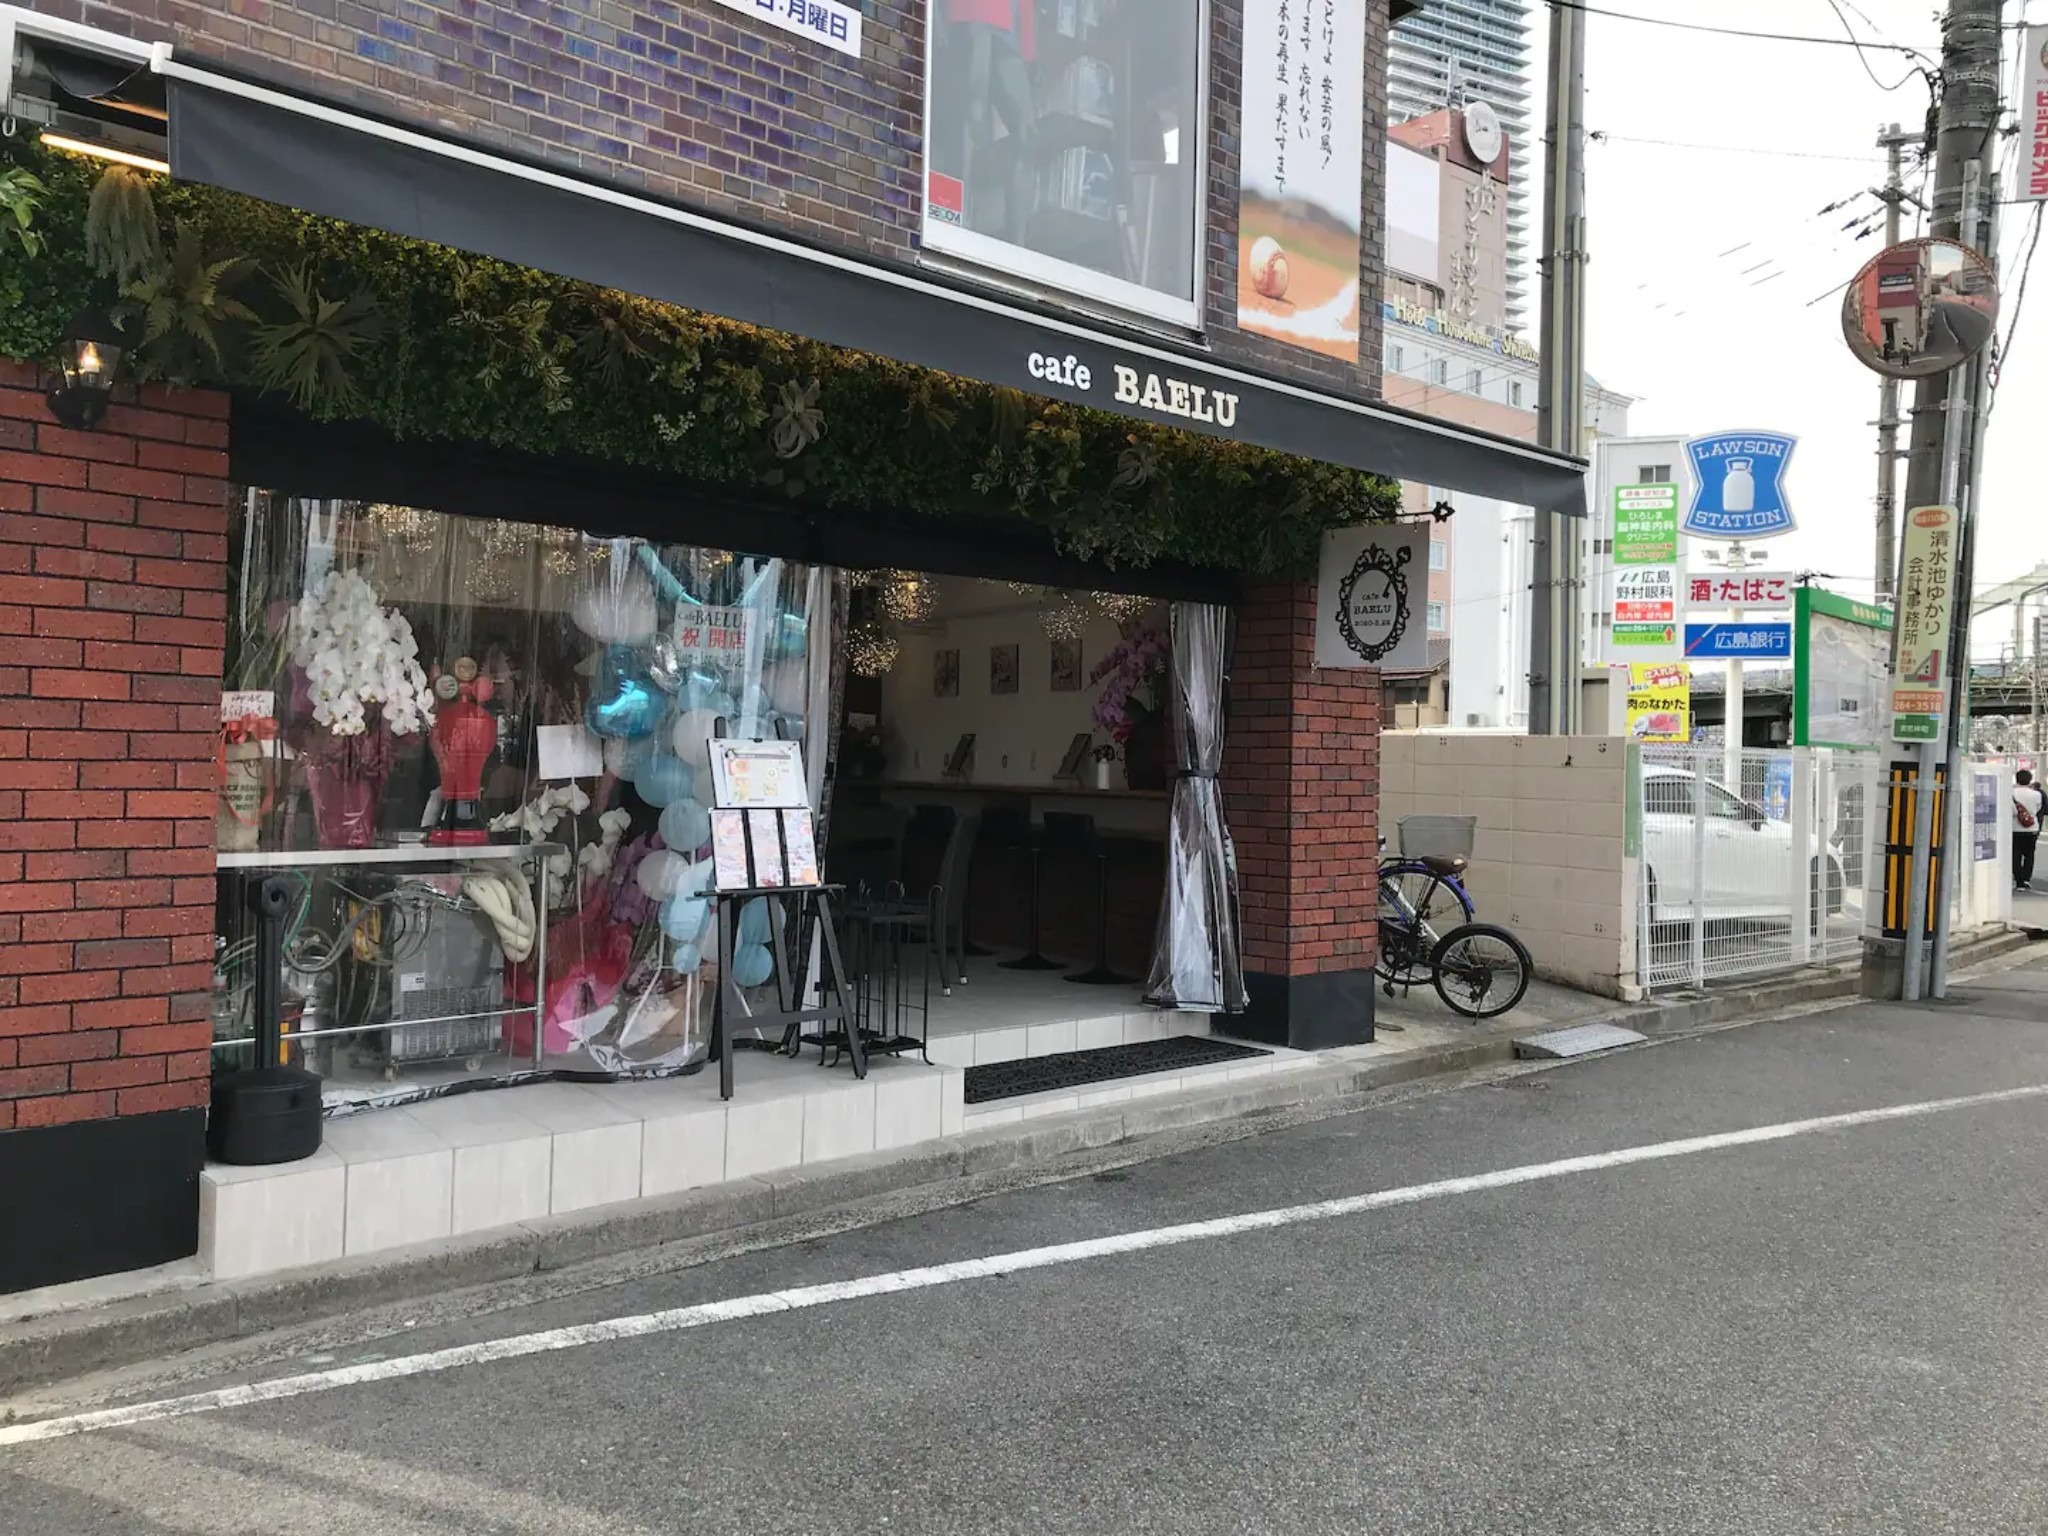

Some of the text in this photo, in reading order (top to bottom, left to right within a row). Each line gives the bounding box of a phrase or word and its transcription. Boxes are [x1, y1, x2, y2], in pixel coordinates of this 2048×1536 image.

[1028, 352, 1240, 428] cafe BAELU
[1696, 440, 1785, 460] LAWSON
[1694, 508, 1782, 528] STATION
[1626, 532, 1665, 541] クリニック
[1641, 570, 1671, 583] 広島
[1925, 530, 1951, 637] 清水池ゆかり
[1616, 585, 1673, 599] 野村眼科
[1690, 578, 1786, 602] 酒・たばこ
[1354, 605, 1392, 615] BAELU
[1903, 556, 1925, 646] 会計事務所
[695, 608, 743, 628] BAELU
[681, 627, 700, 648] 祝
[1714, 630, 1787, 649] 広島銀行
[1627, 698, 1687, 710] 肉のなかた
